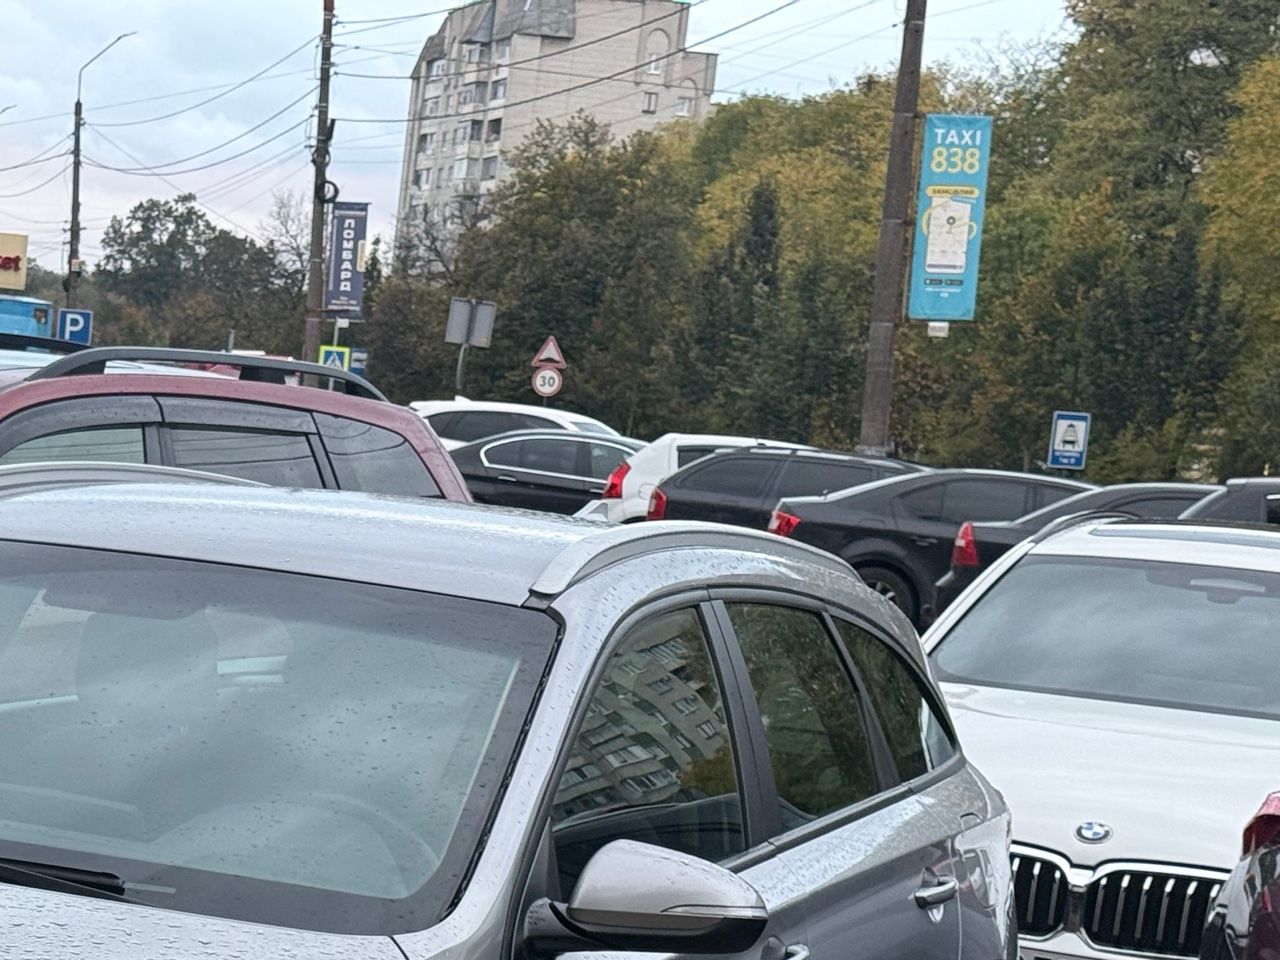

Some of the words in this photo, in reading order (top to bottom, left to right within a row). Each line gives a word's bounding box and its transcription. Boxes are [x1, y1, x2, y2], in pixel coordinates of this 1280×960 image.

[934, 128, 982, 146] TAXI
[931, 147, 980, 174] 838
[339, 218, 356, 292] ЛОМБАРД
[64, 313, 85, 341] P
[539, 375, 556, 388] 30
